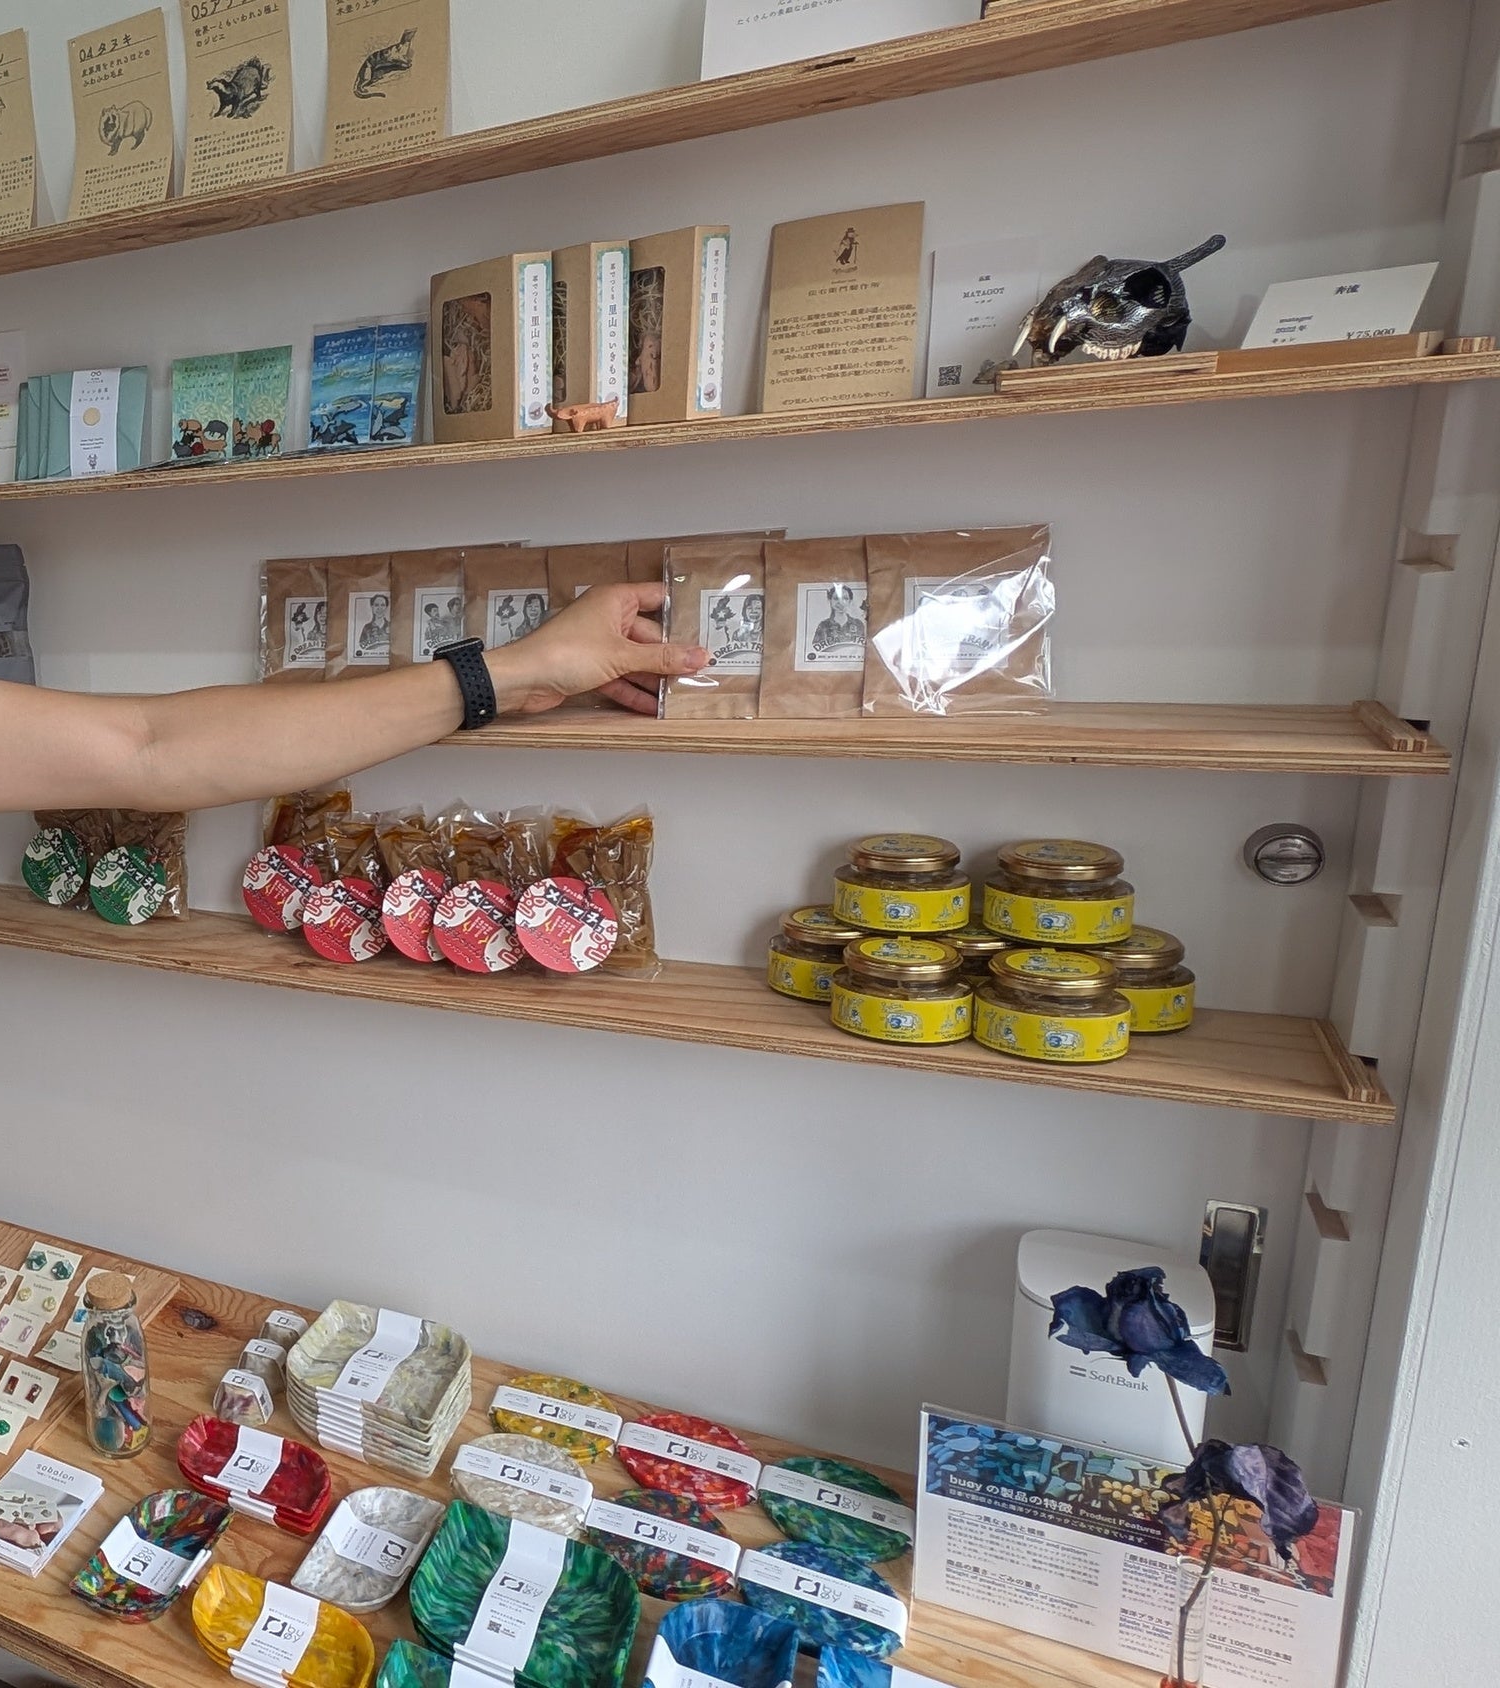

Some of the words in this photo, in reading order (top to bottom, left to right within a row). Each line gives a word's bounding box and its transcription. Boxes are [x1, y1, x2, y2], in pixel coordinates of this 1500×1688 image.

[963, 287, 1005, 298] MATAGOT
[607, 304, 619, 386] 里山のいきもの
[707, 292, 720, 377] 里山のいきもの
[530, 315, 541, 396] 里山のいきもの
[712, 642, 750, 660] DREAM
[1089, 1370, 1149, 1391] SoftBank
[36, 1463, 76, 1482] sobolon
[986, 1483, 1074, 1515] の製品の特徴
[1079, 1508, 1118, 1525] Product
[1118, 1518, 1162, 1537] Features
